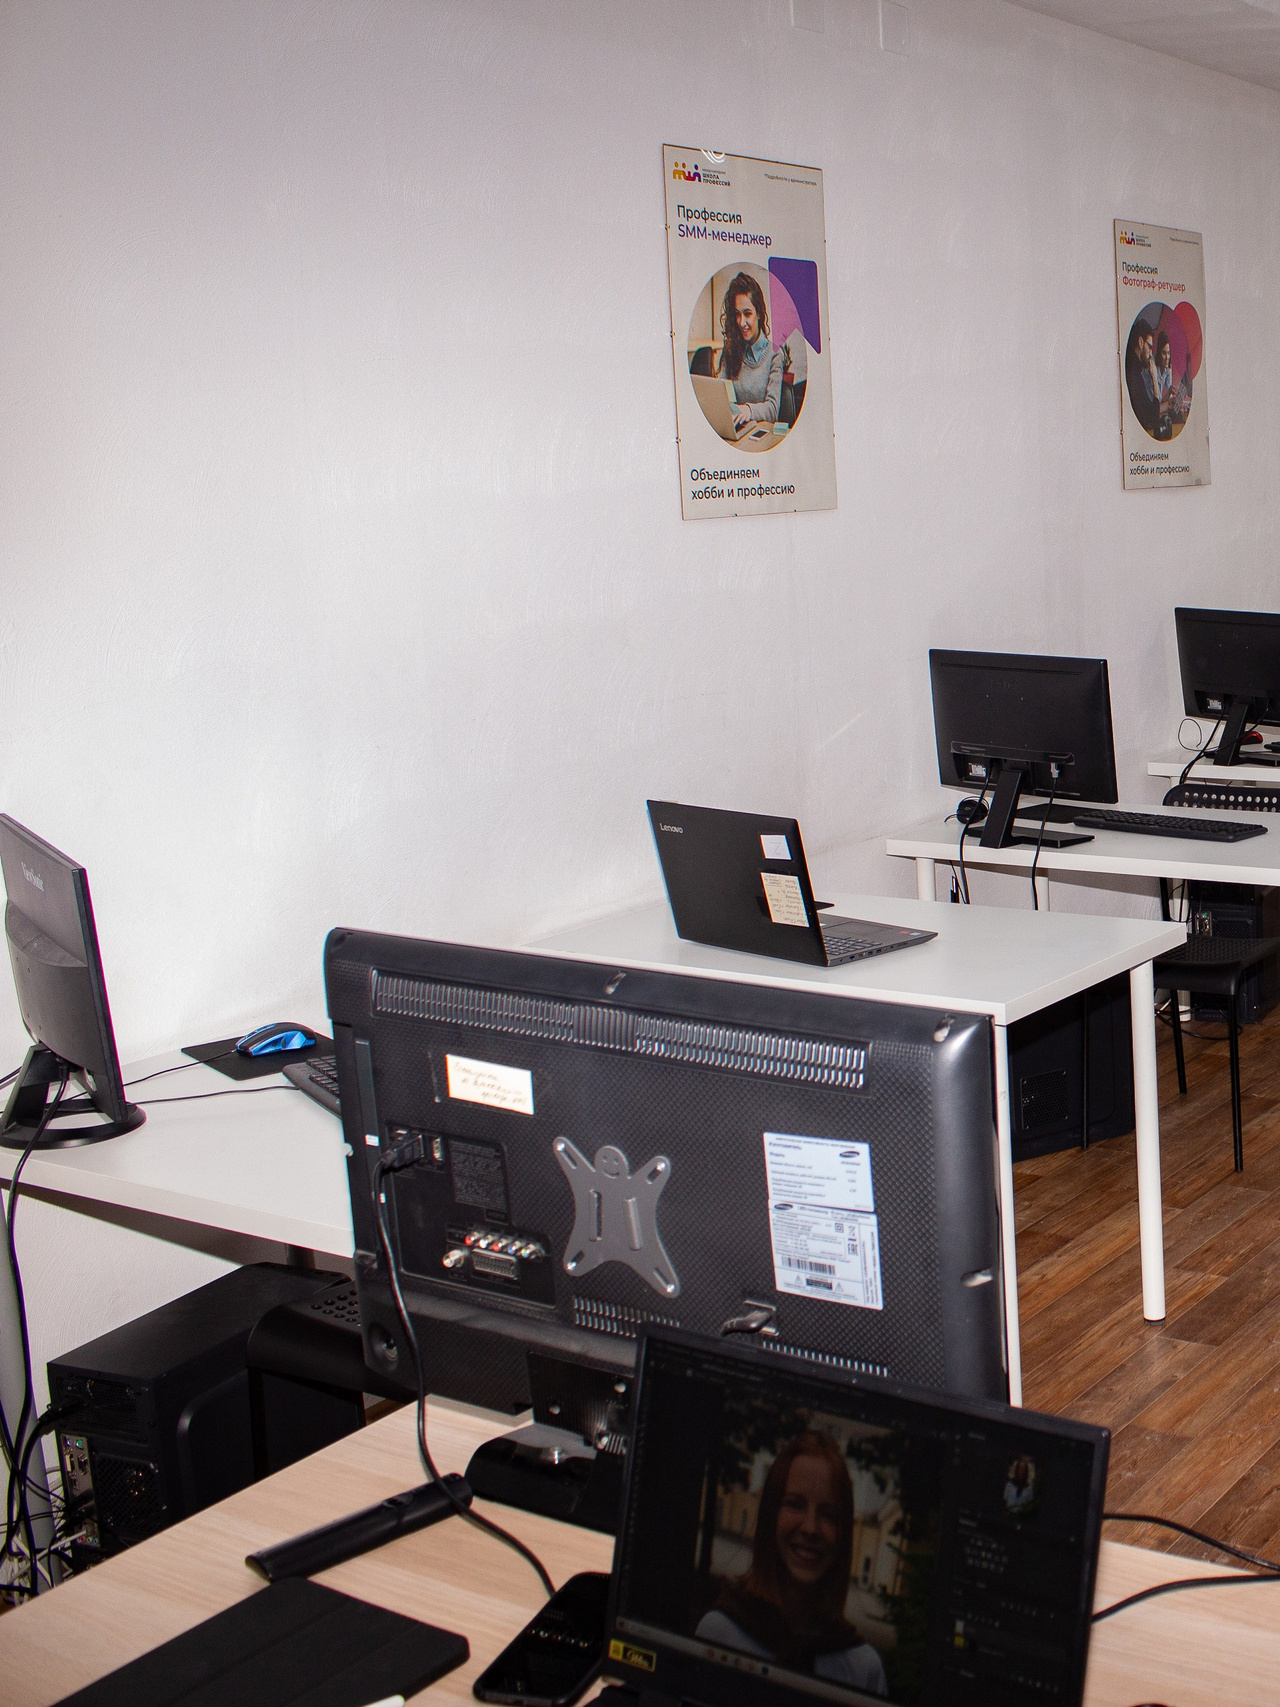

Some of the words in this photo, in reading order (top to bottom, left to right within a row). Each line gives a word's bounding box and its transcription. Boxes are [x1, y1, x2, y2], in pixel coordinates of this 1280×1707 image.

[703, 178, 731, 187] ПРОФЕССИЙ
[677, 204, 743, 225] Профессия
[678, 224, 773, 249] SMM-менеджер
[1122, 261, 1159, 275] Профессия
[1122, 276, 1186, 293] Фотограф-ретушер
[1129, 451, 1169, 462] Объединяем
[690, 467, 760, 482] Объединяем
[1129, 465, 1149, 476] хобби
[1150, 467, 1155, 475] и
[1156, 464, 1190, 476] профессию
[691, 485, 725, 500] хобби
[727, 487, 735, 498] и
[737, 484, 796, 500] профессию
[659, 822, 684, 834] Lenovo
